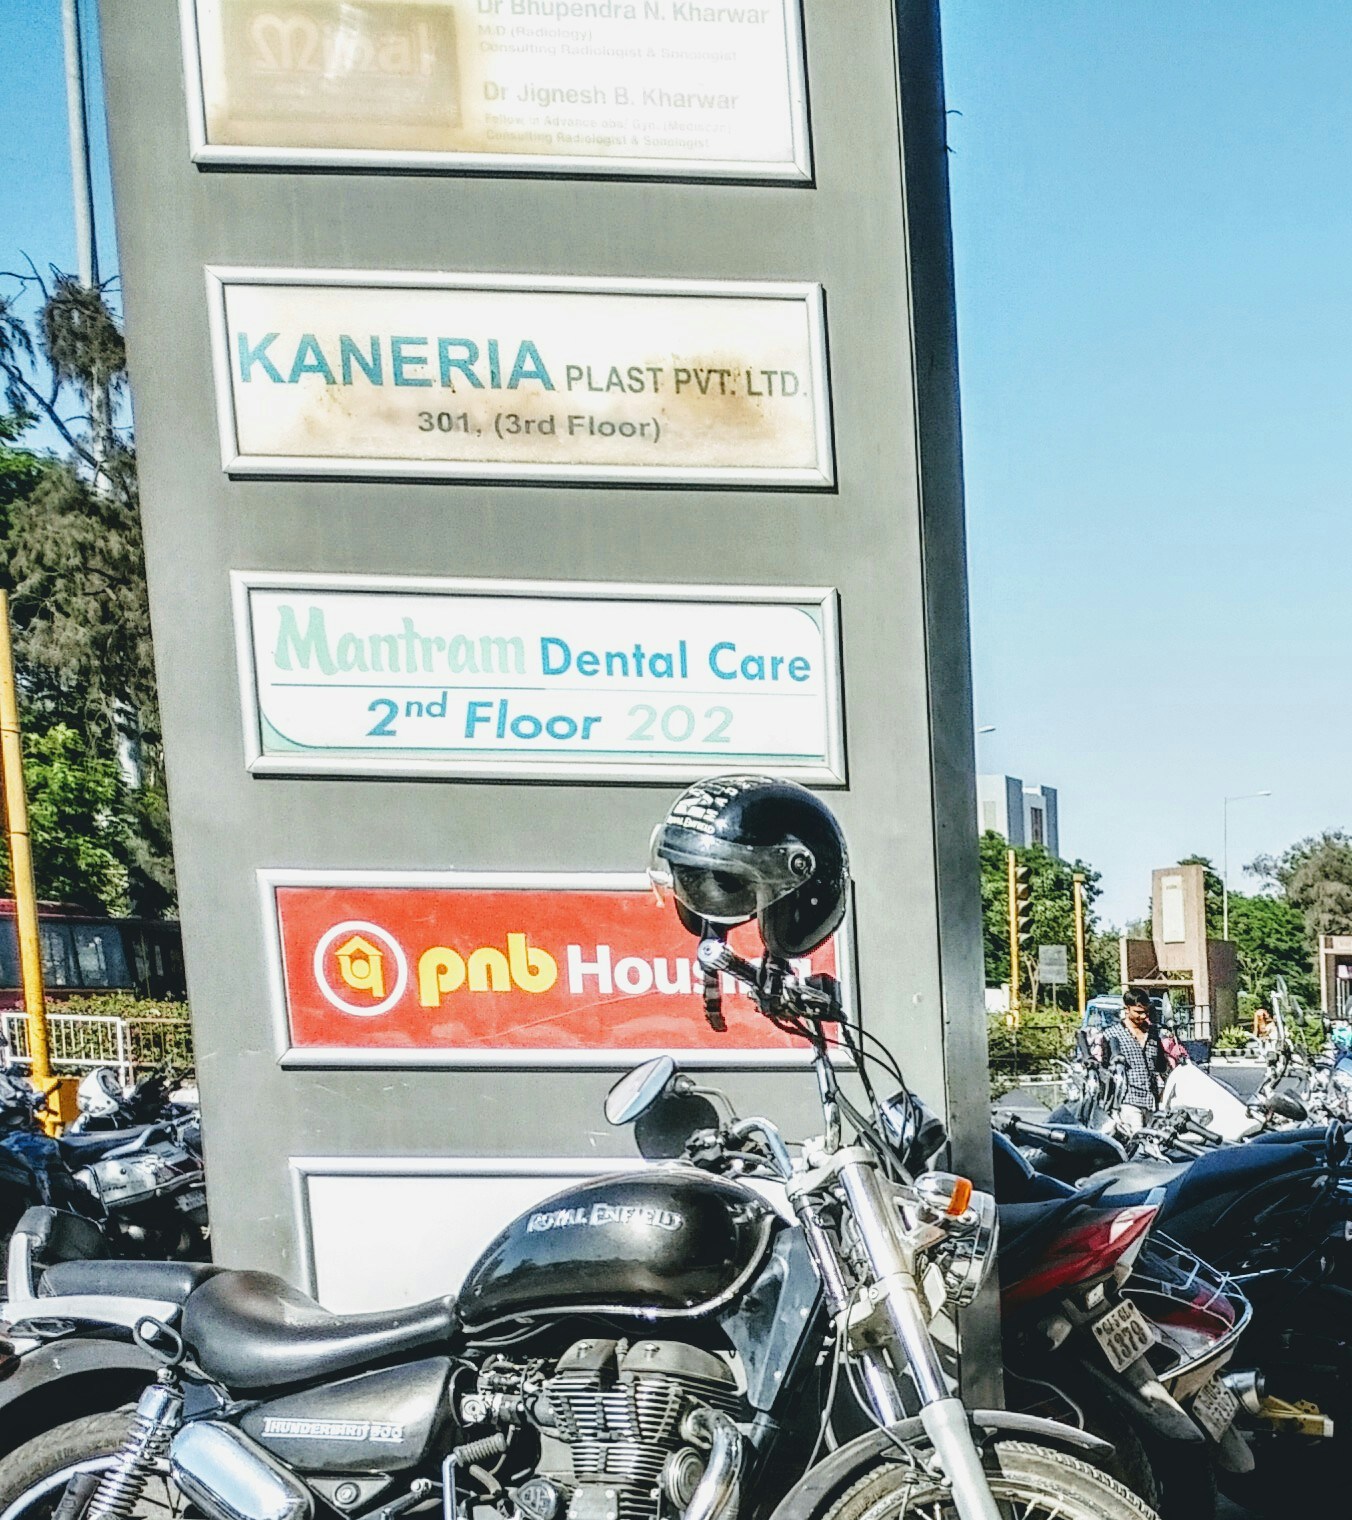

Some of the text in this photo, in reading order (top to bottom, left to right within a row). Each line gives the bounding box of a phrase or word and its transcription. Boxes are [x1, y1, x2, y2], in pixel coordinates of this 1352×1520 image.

[511, 0, 637, 21] Bhupendra
[644, 0, 666, 21] N.
[673, 0, 771, 24] Kharwar
[483, 80, 740, 109] Dr Jignesh B. Kharwar
[236, 331, 808, 397] KANERIA PLAST PVT. LTD.
[418, 411, 662, 443] 301, (3rd Floor)
[273, 605, 812, 683] Mantram Dental Care
[366, 691, 735, 745] 2nd Floor 202
[419, 932, 559, 1008] pnb
[588, 1202, 687, 1232] ENFIELD
